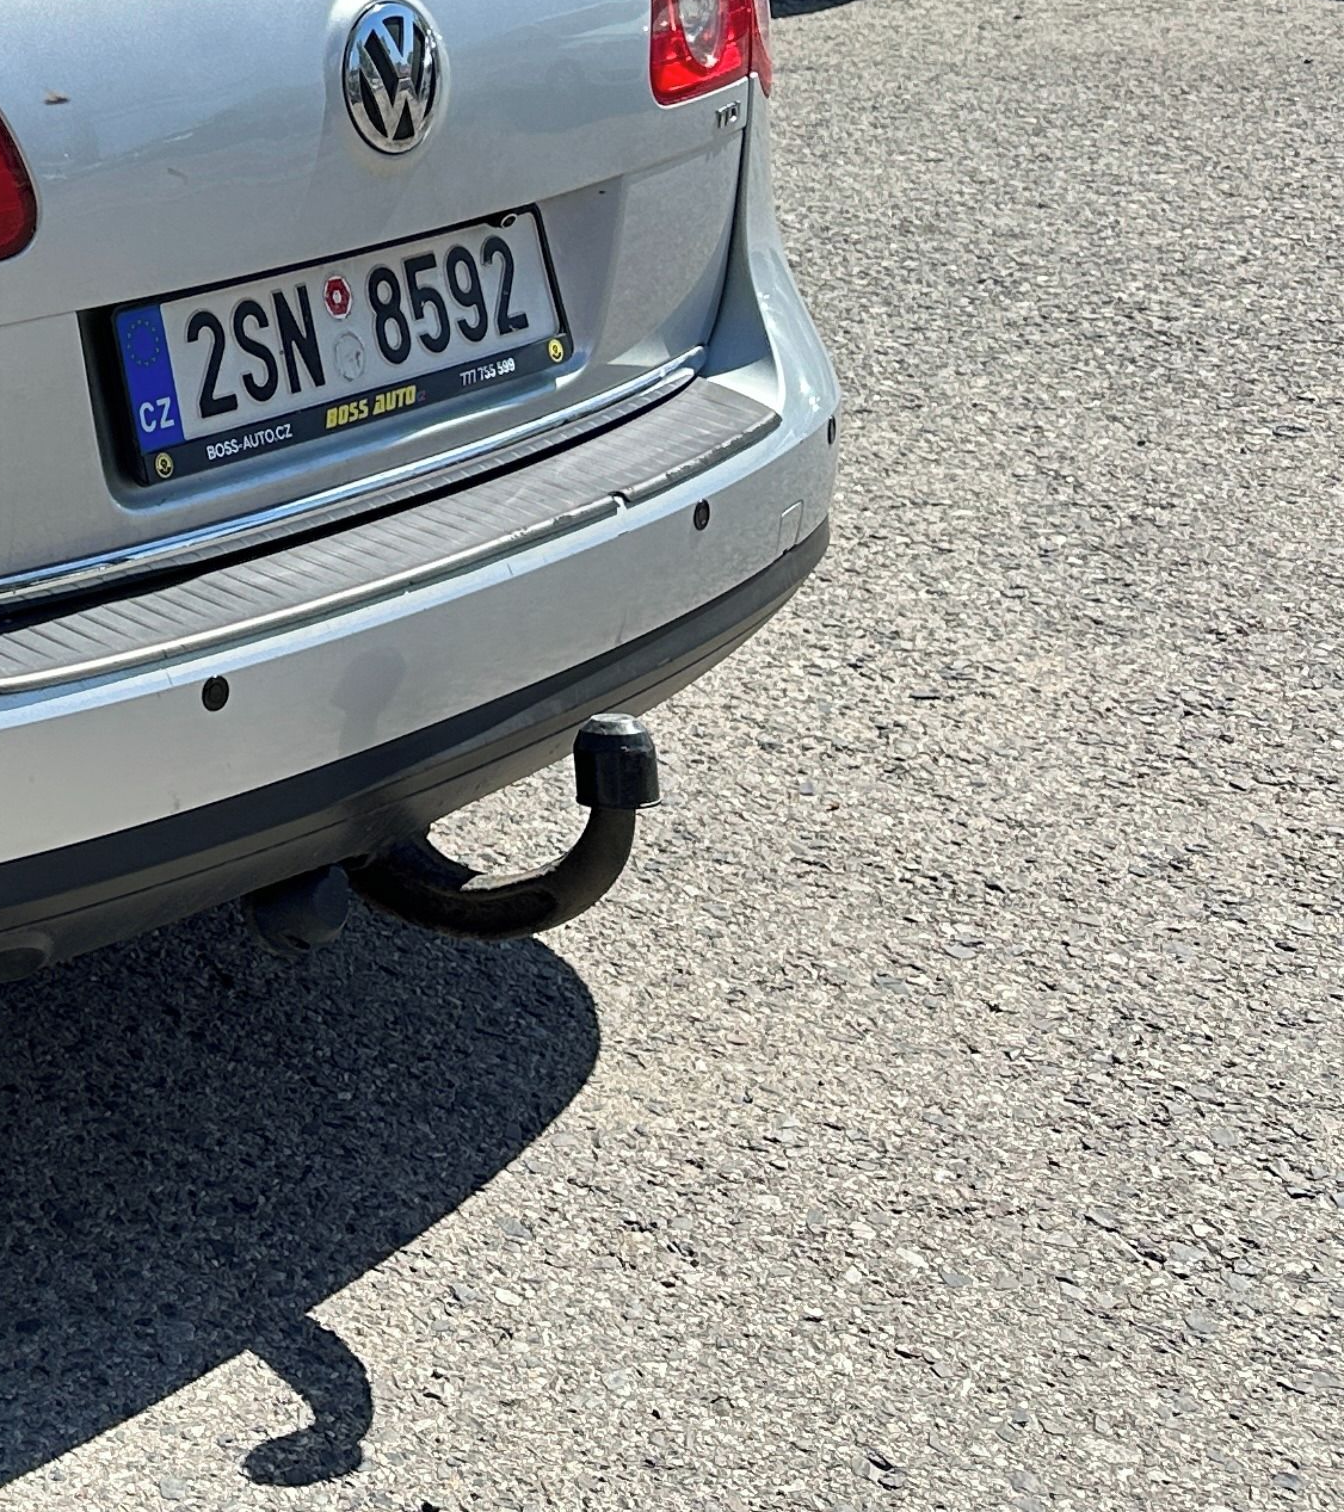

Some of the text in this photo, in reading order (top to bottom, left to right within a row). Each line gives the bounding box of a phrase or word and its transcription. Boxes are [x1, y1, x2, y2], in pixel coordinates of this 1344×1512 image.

[185, 236, 530, 419] 2SN 8592
[459, 369, 477, 386] 777
[477, 363, 496, 381] 755
[139, 396, 176, 433] CZ
[325, 399, 369, 429] BOSS
[372, 385, 417, 415] AUTO
[205, 424, 294, 460] BOSS-AUTO.CZ
